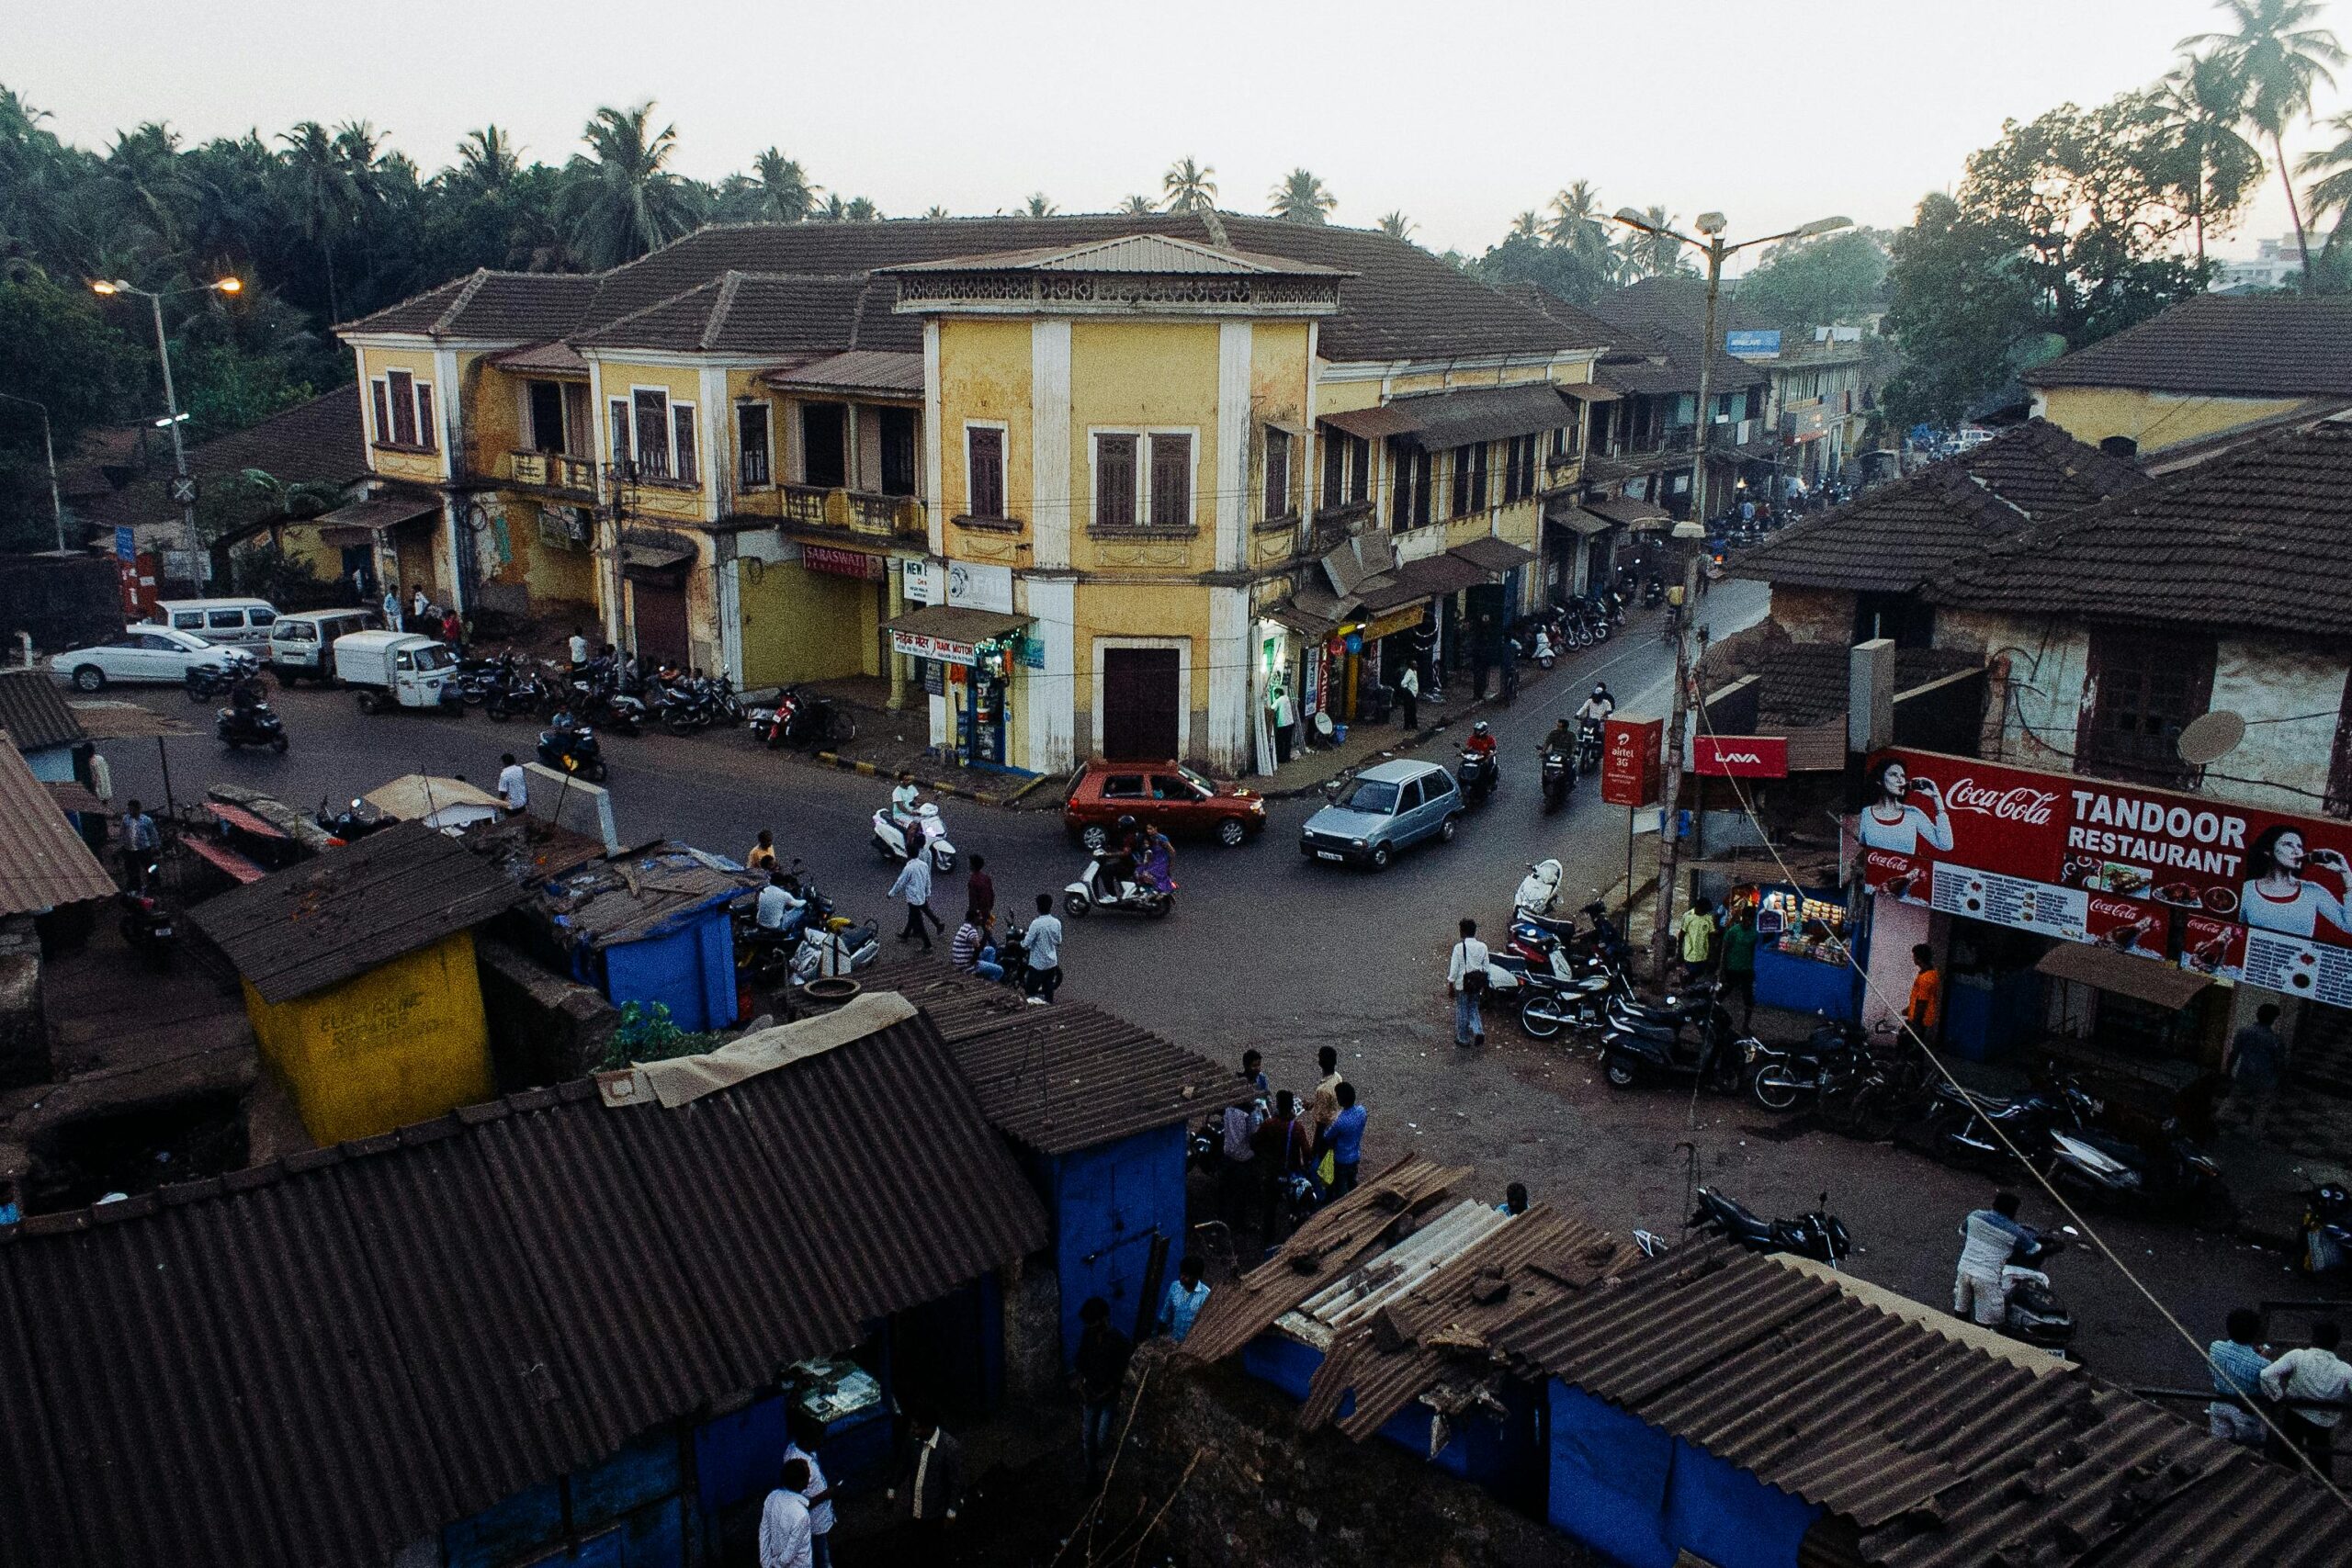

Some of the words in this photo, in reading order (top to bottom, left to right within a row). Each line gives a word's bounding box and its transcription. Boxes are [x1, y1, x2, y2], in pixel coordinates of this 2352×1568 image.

[806, 547, 865, 568] SARASWATI
[906, 561, 922, 575] NEW
[1611, 747, 1634, 758] airtel
[1714, 752, 1762, 764] LAVA
[1616, 758, 1629, 767] 3G
[1945, 778, 2061, 825] Coca-Cola
[2072, 791, 2246, 849] TANDOOR
[2068, 827, 2242, 877] RESTAURANT
